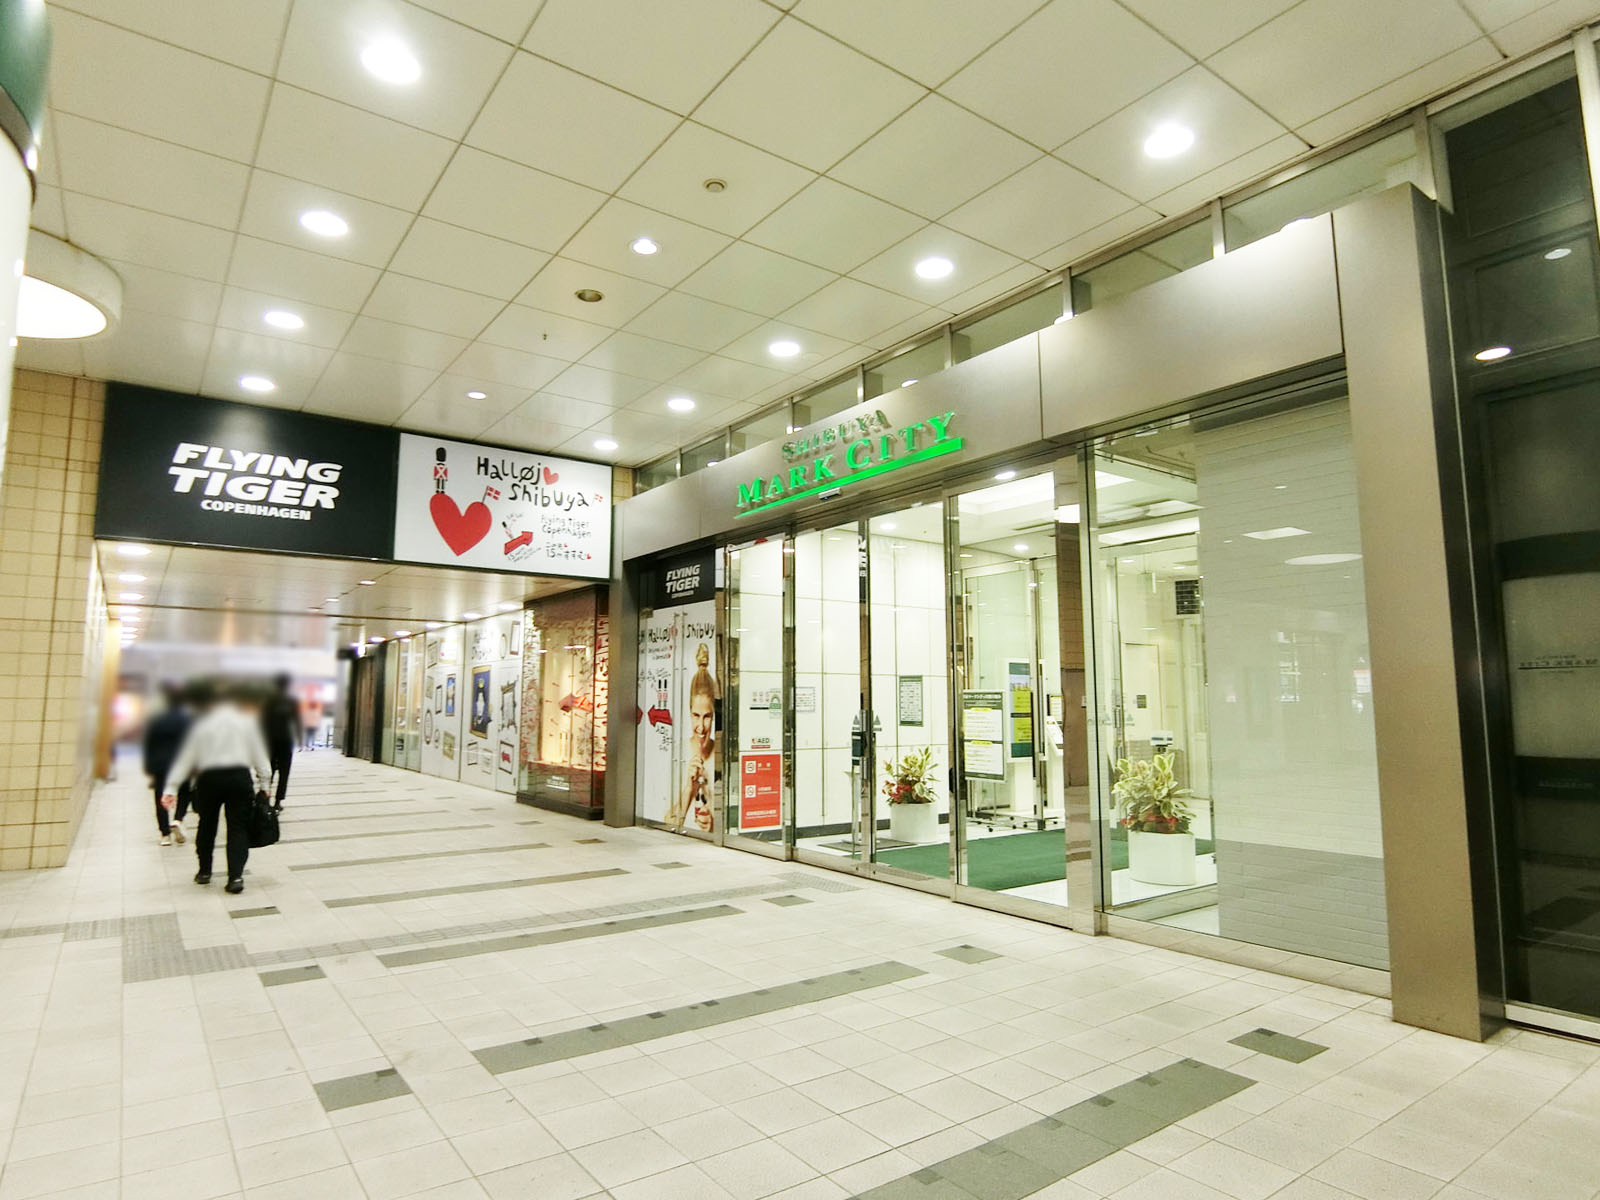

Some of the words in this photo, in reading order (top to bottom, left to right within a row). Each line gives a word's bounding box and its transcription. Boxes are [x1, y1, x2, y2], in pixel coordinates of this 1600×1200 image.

[781, 409, 891, 461] SHIBUYA
[172, 442, 343, 483] FLYING
[477, 456, 541, 485] Halløj
[736, 454, 834, 507] MARK
[846, 411, 956, 469] CITY
[168, 466, 340, 509] TIGER
[508, 483, 589, 511] Shibuya
[200, 499, 311, 521] COPENHAGEN
[542, 524, 592, 539] Copenhagen
[665, 576, 700, 594] TIGER
[666, 564, 701, 581] FLYING
[686, 623, 715, 639] Shibuy
